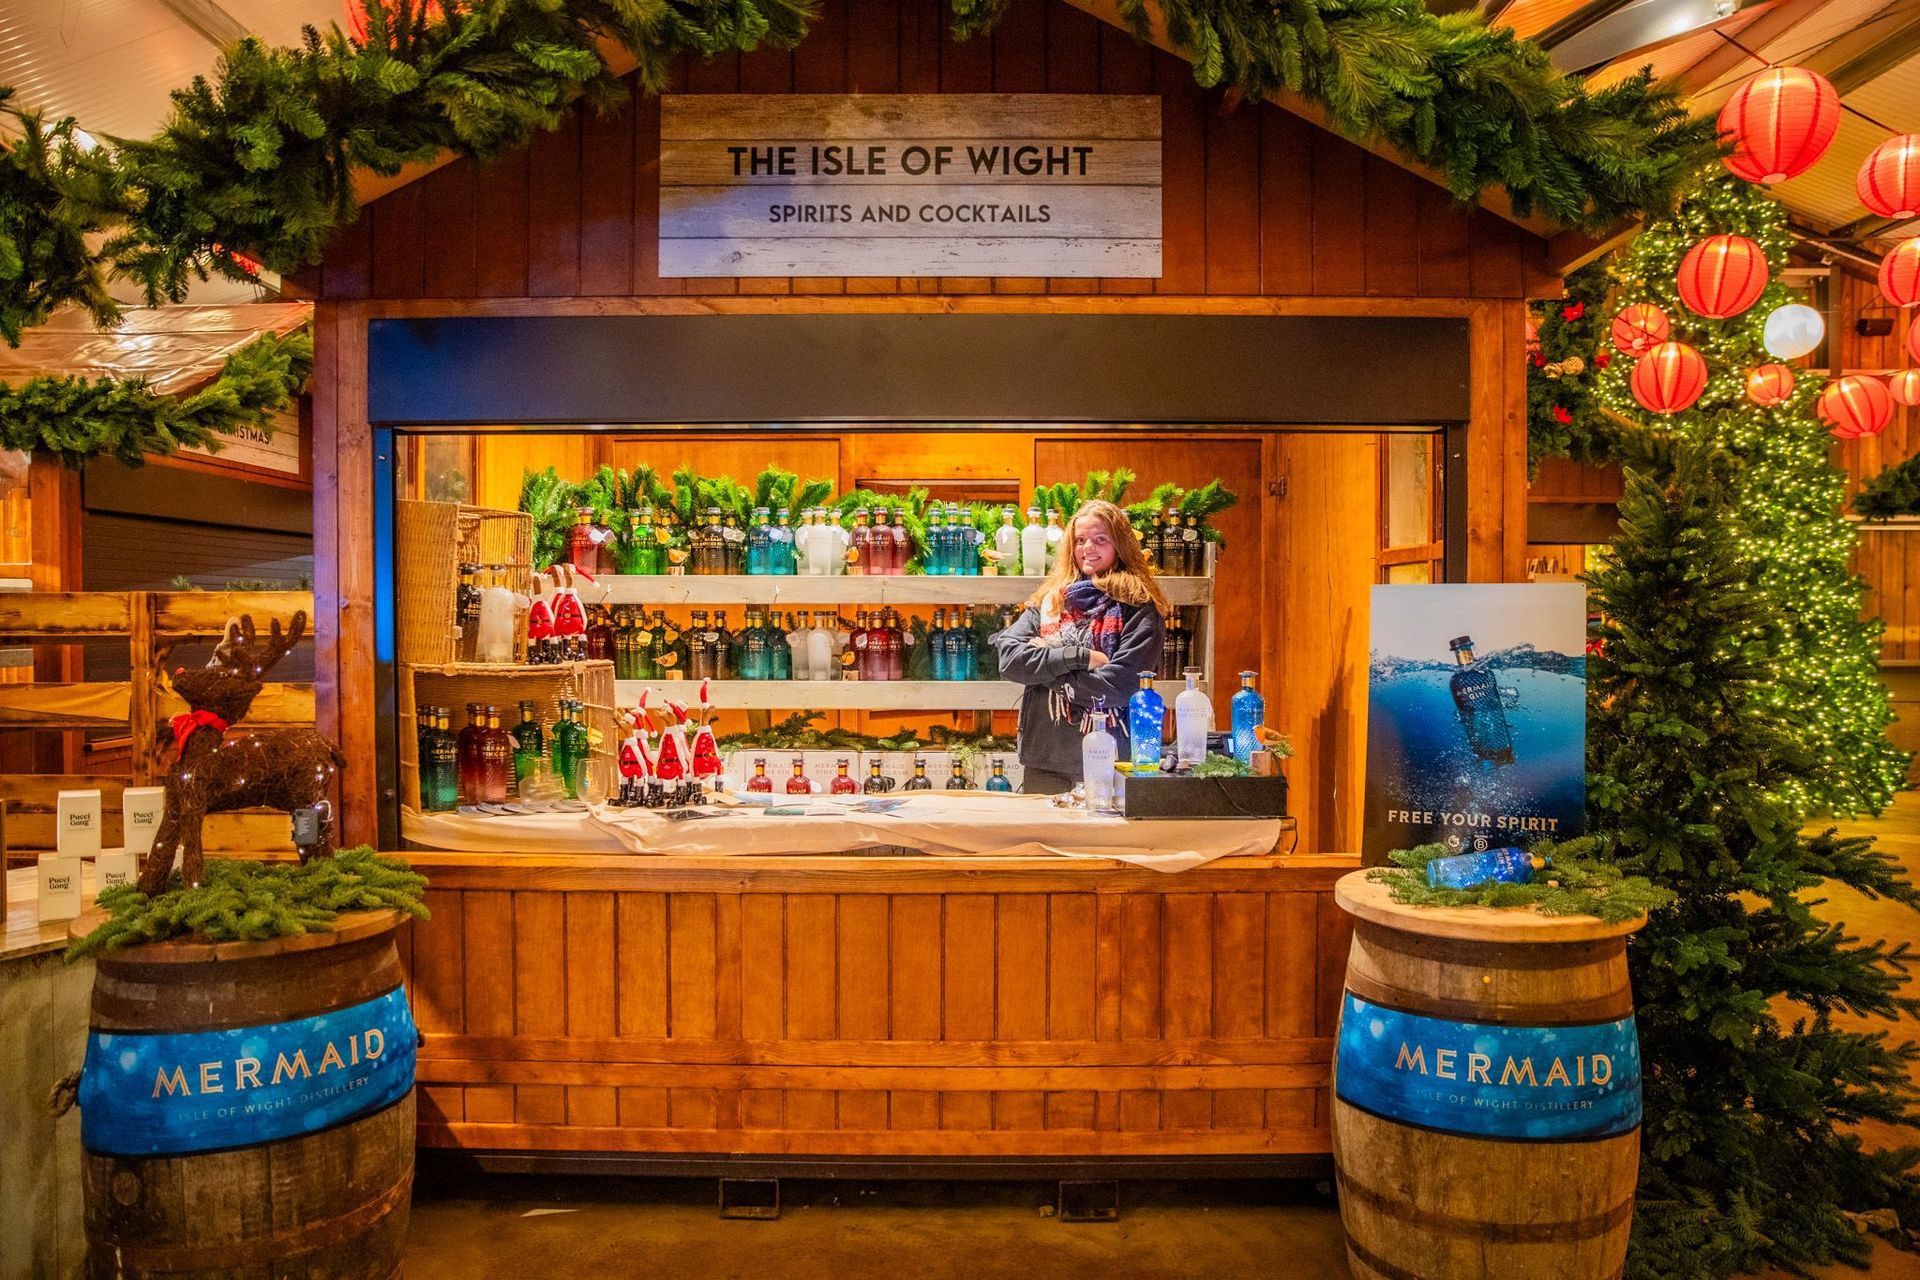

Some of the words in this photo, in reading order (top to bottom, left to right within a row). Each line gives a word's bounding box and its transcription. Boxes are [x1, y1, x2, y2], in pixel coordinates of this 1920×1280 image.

[727, 146, 797, 176] THE
[811, 146, 887, 176] ISLE
[900, 146, 953, 176] OF
[966, 146, 1094, 176] WIGHT
[768, 204, 853, 224] SPIRITS
[861, 204, 912, 224] AND
[918, 204, 1052, 224] COCKTAILS
[1468, 690, 1486, 700] GIN
[69, 813, 91, 821] Pucci
[132, 811, 154, 819] Pucci
[1387, 809, 1433, 825] FREE
[1440, 811, 1491, 828] YOUR
[1496, 815, 1558, 832] SPIRIT
[48, 875, 71, 884] Pucci
[105, 871, 126, 879] Pucci
[152, 1028, 385, 1098] MERMAID
[1394, 1040, 1613, 1087] MERMAID
[179, 1111, 209, 1121] ISLE
[217, 1107, 237, 1118] OF
[244, 1096, 293, 1114] WIGHT
[299, 1076, 370, 1104] DISTILLERY
[1449, 1094, 1466, 1104] OF
[1473, 1098, 1518, 1109] WIGHT
[1524, 1100, 1594, 1111] DISTILLERY
